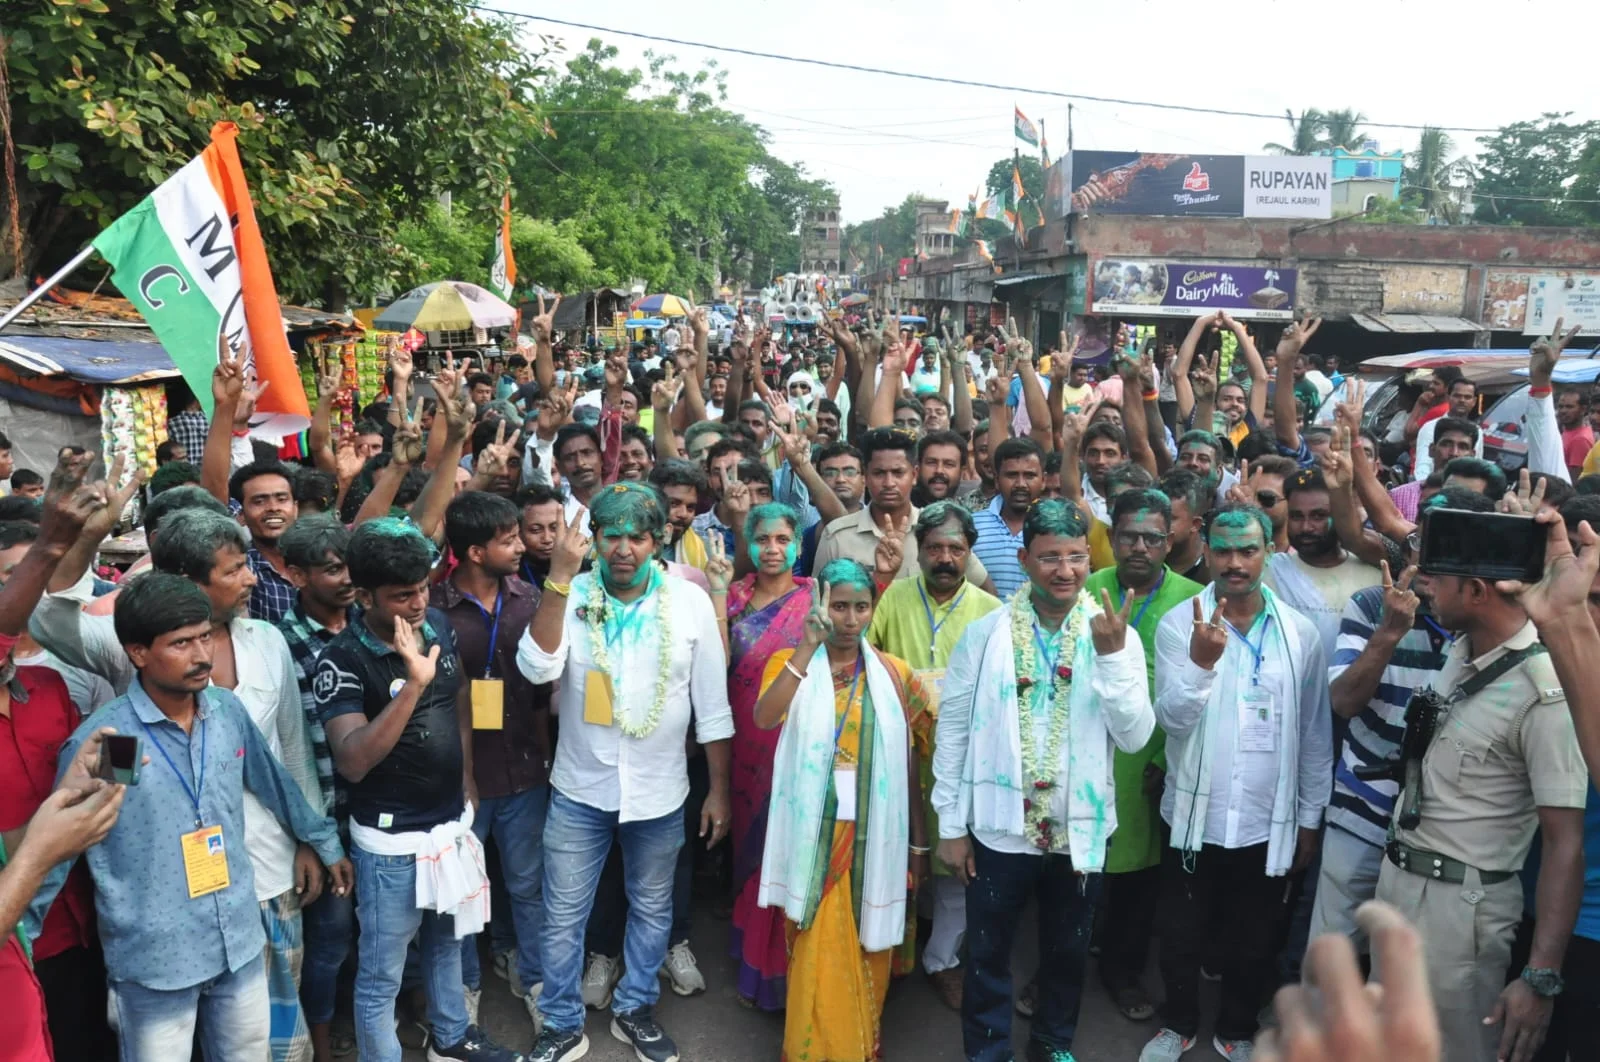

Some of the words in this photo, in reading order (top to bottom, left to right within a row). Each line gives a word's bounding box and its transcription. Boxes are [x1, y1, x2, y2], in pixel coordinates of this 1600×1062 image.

[1250, 171, 1327, 190] RUPAYAN
[1256, 195, 1289, 205] (REJAUL
[1291, 196, 1321, 206] KARIM)
[184, 212, 236, 282] M
[139, 264, 190, 310] C
[1183, 270, 1218, 286] Cadbury
[1175, 285, 1212, 302] Dairy
